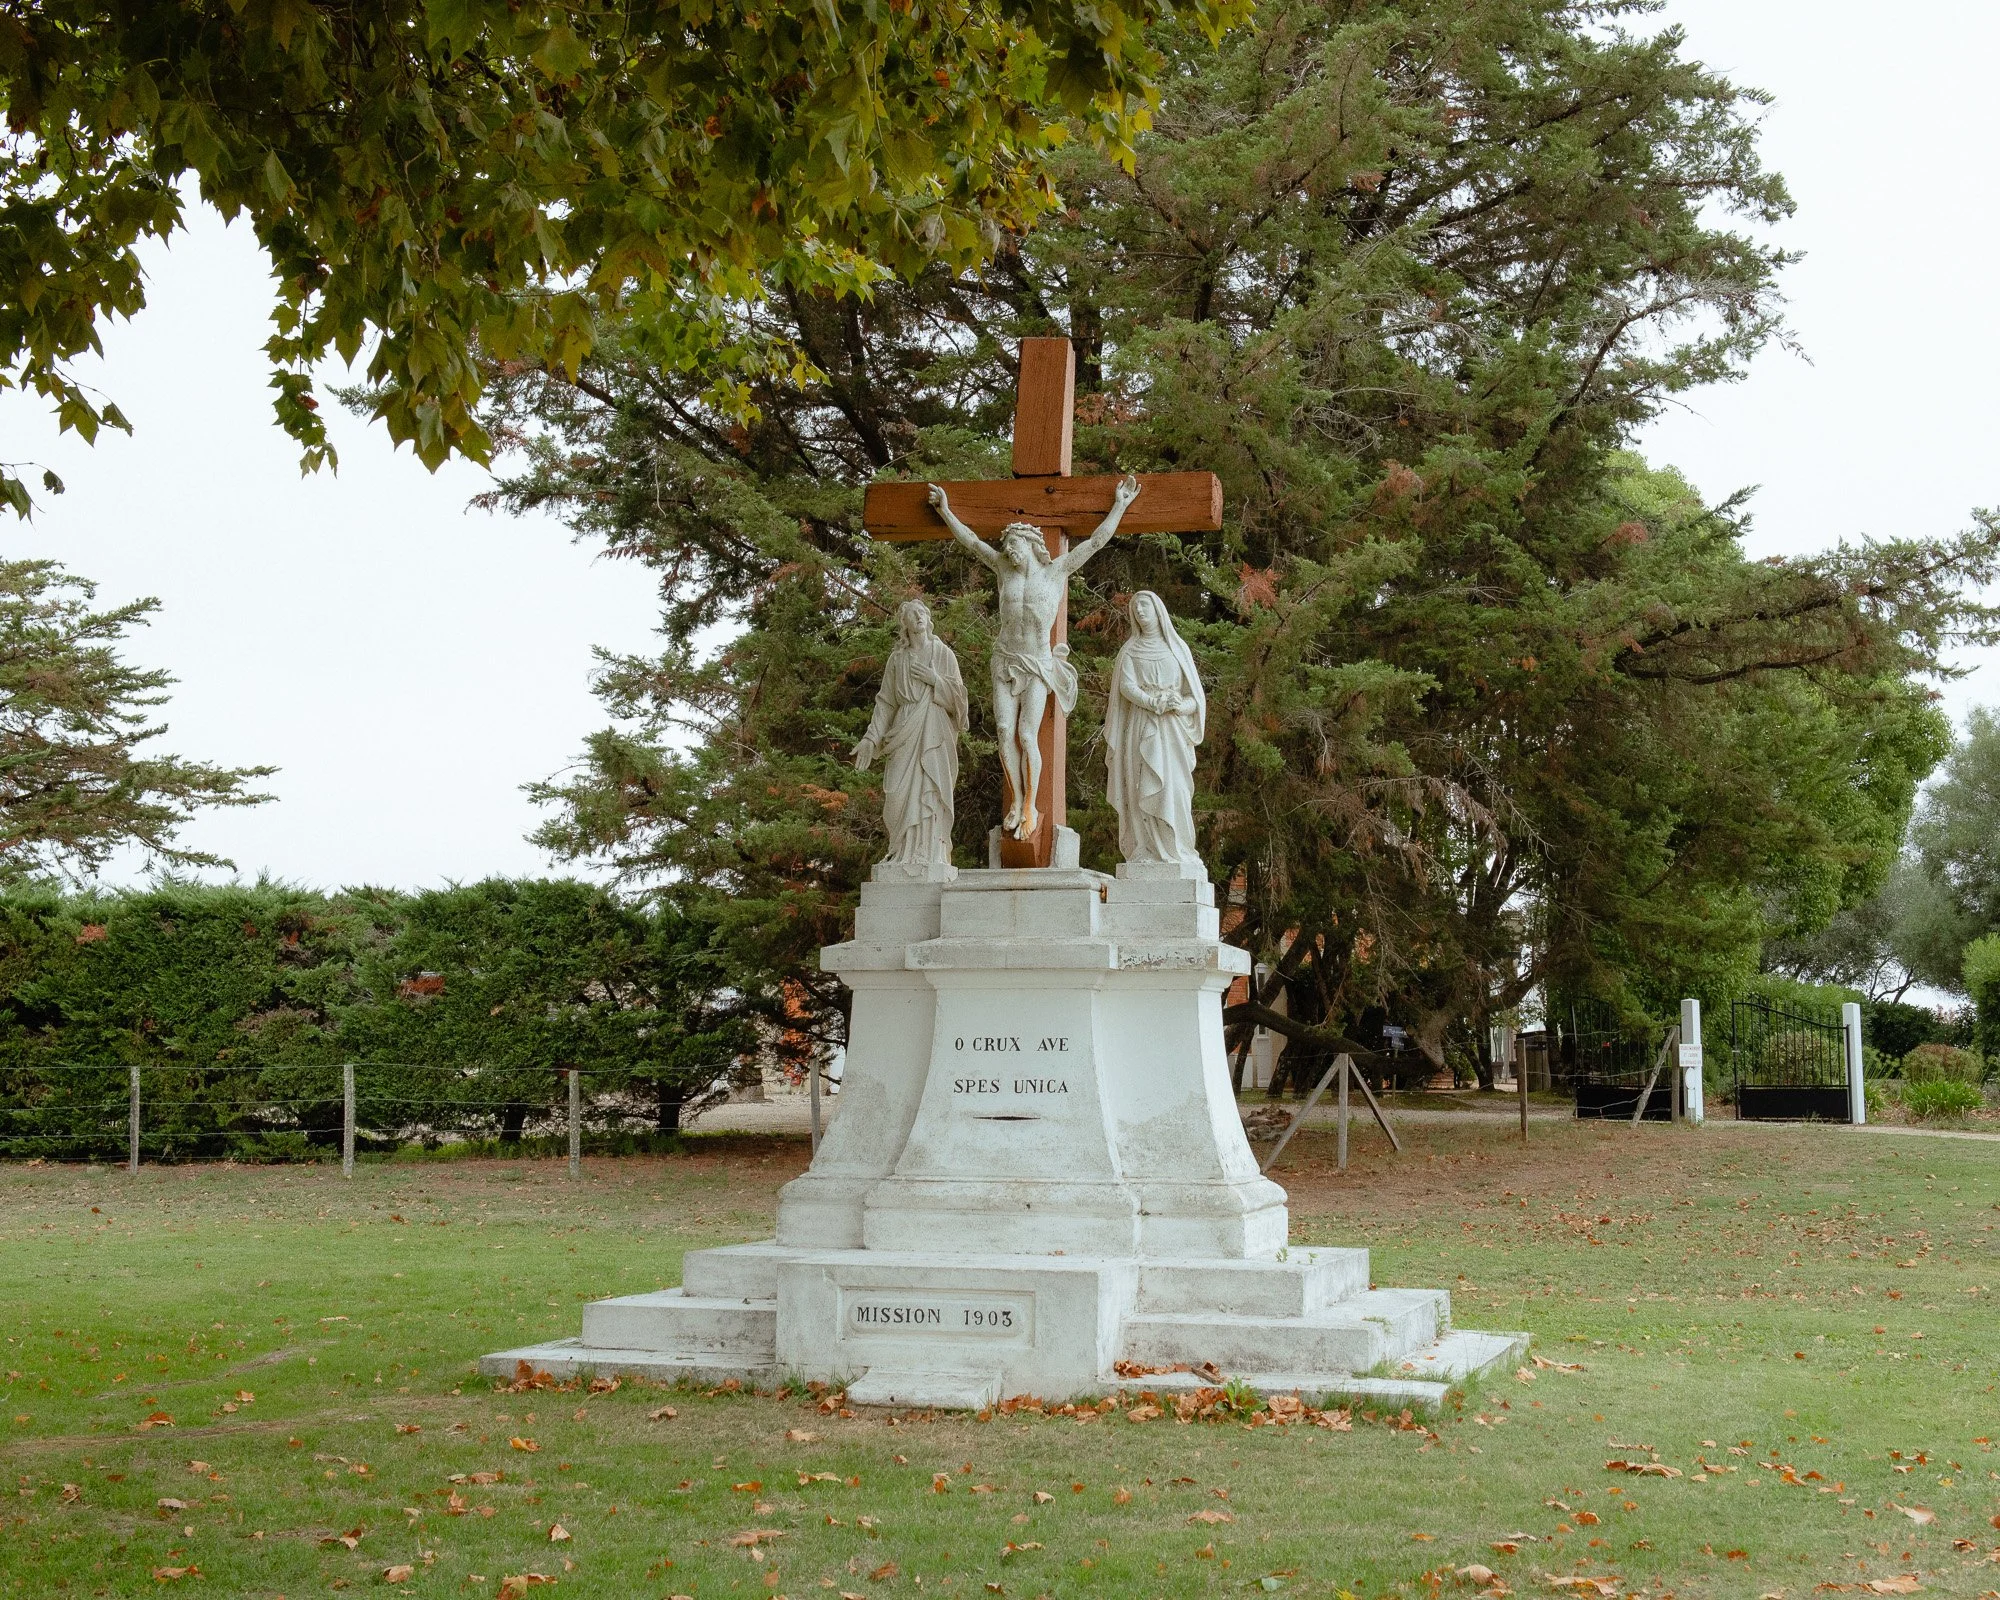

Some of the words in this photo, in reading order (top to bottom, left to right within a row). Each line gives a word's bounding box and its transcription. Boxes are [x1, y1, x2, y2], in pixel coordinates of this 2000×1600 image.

[955, 1037, 964, 1051] O
[972, 1037, 1021, 1051] CRUX
[1037, 1037, 1069, 1051] AVE
[953, 1079, 1000, 1093] SPES
[1014, 1079, 1068, 1093] UNICA
[857, 1306, 941, 1324] MISSION
[963, 1309, 1013, 1327] 1903
